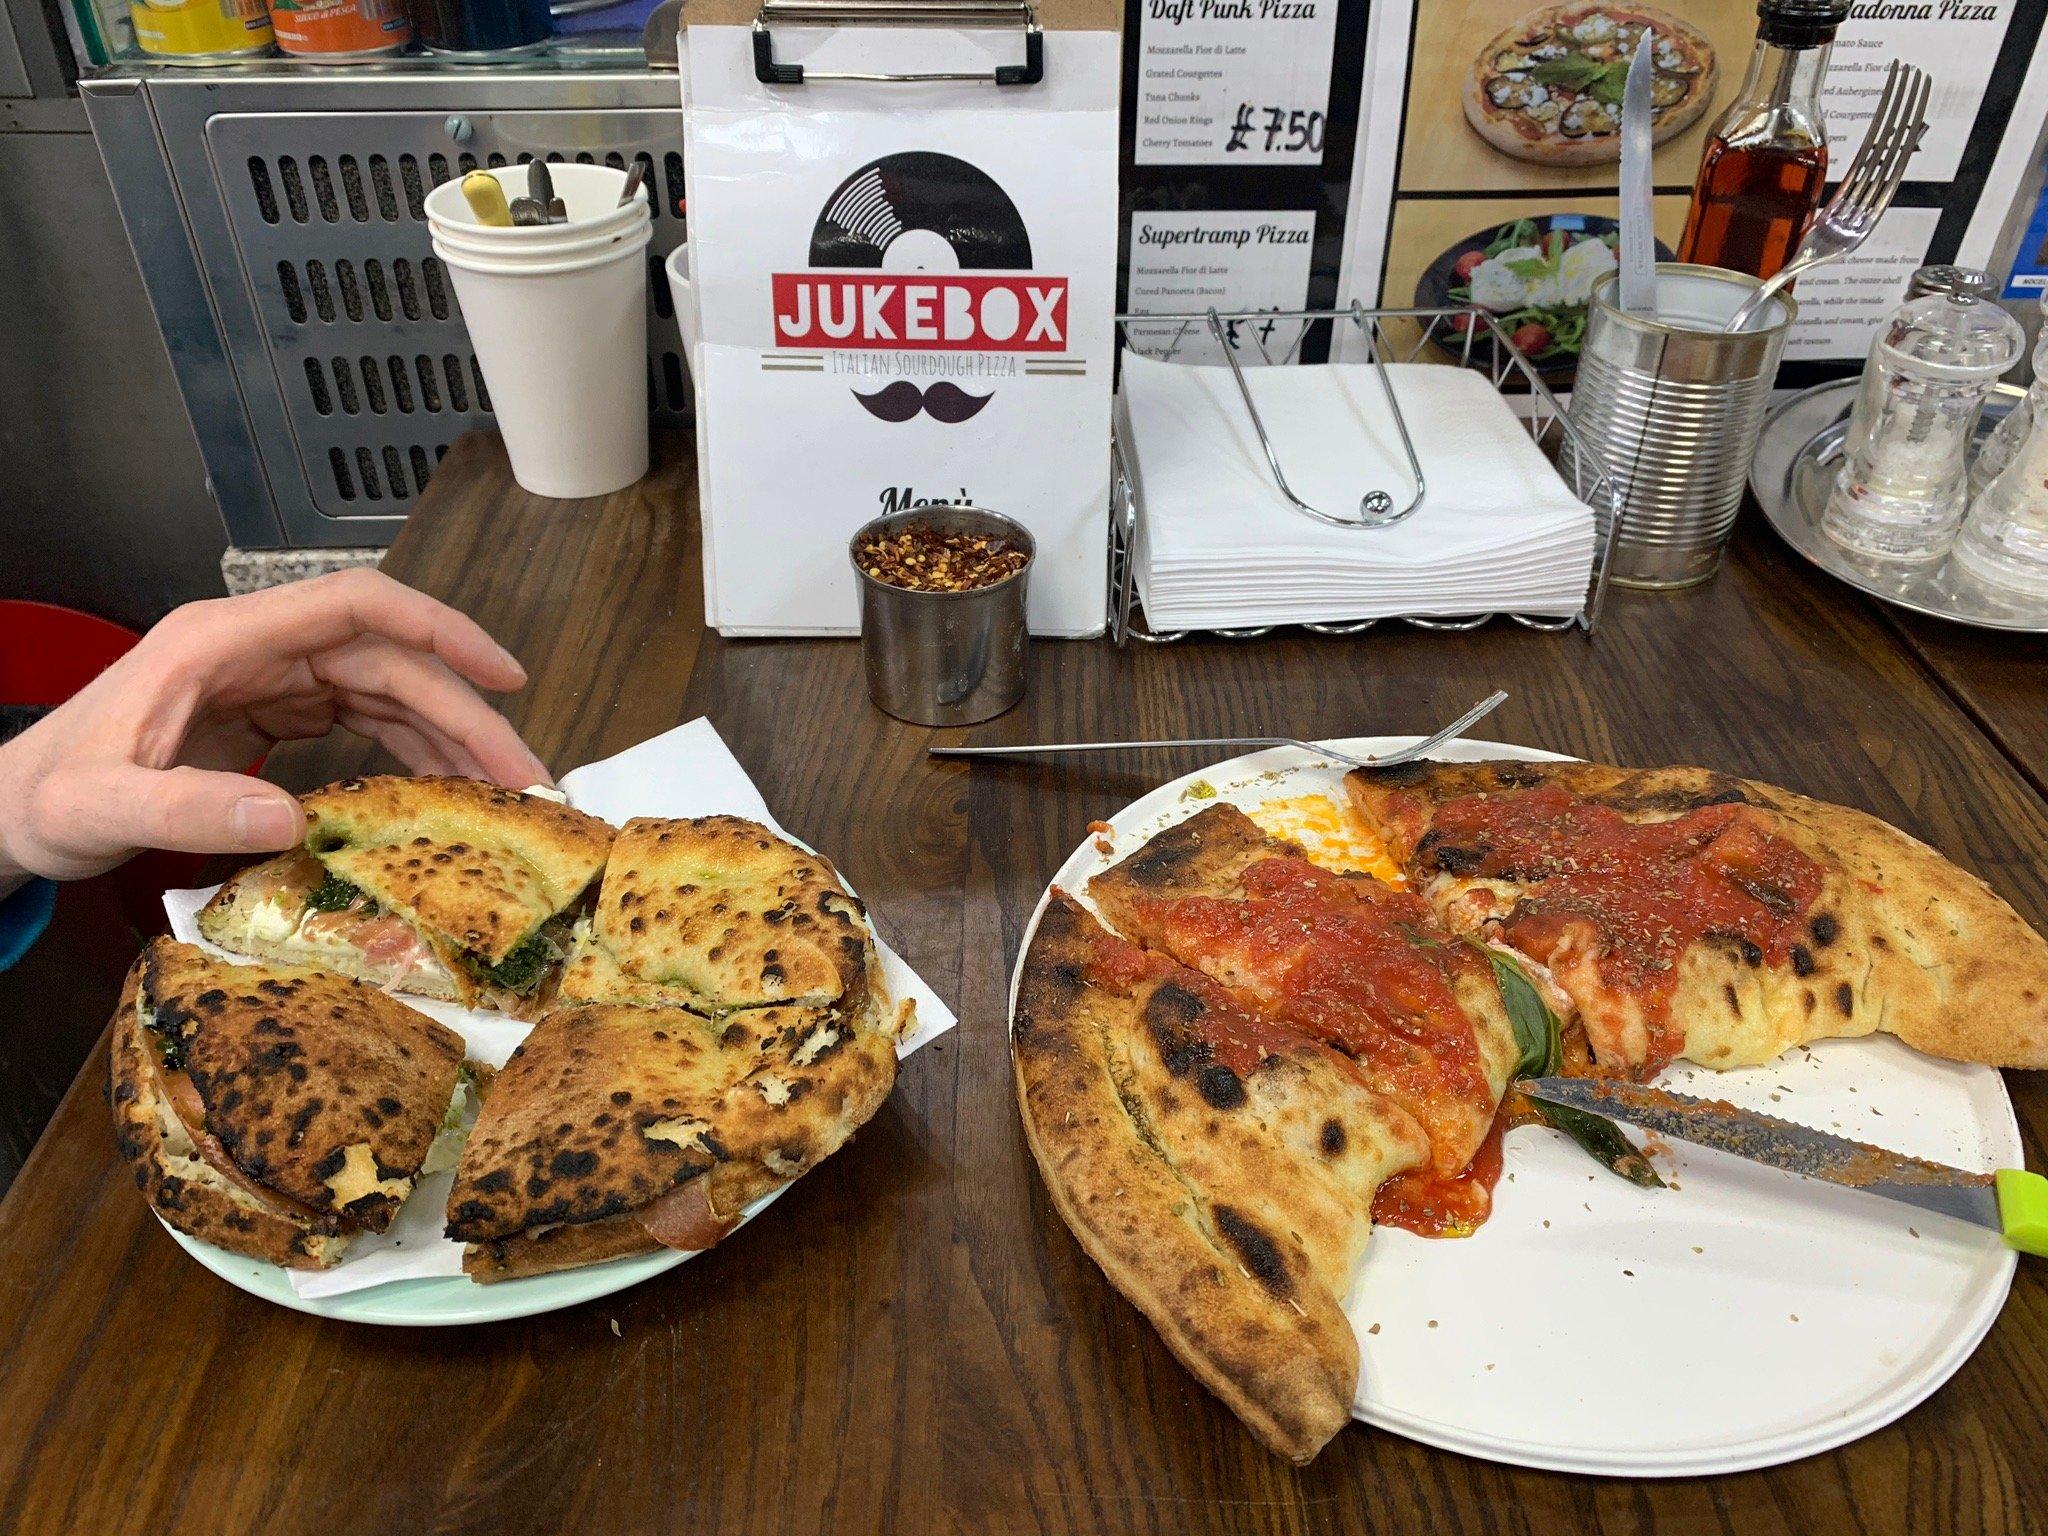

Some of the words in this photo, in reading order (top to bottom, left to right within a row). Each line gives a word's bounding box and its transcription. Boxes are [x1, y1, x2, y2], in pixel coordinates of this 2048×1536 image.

[1149, 0, 1194, 25] Daft
[1200, 0, 1253, 19] Punk
[1259, 0, 1317, 20] Pizza
[1850, 0, 1932, 21] adonna
[1938, 0, 1998, 21] Pizza
[1858, 39, 1884, 48] Sauce
[1147, 45, 1194, 55] Mozzarella
[1195, 45, 1213, 55] Fior
[1214, 45, 1223, 55] di
[1225, 45, 1247, 55] Latte
[1865, 63, 1883, 72] Fior
[1145, 69, 1174, 79] Grated
[1176, 69, 1223, 81] Courgettes
[1145, 92, 1166, 102] Tuna
[1168, 92, 1200, 102] Chunks
[1144, 116, 1160, 125] Red
[1161, 116, 1188, 125] Onion
[1189, 116, 1213, 127] Rings
[1226, 102, 1326, 153] £7.50
[1142, 138, 1171, 149] Cherry
[1173, 139, 1213, 148] Tomatoes
[1138, 224, 1251, 250] Supertramp
[1256, 224, 1311, 245] Pizza
[1137, 265, 1179, 275] Mozzarella
[1181, 266, 1198, 275] Fior
[1199, 266, 1207, 275] di
[1209, 266, 1228, 275] Latte
[1135, 287, 1160, 296] Cured
[1161, 287, 1195, 296] Pancetta
[1196, 287, 1227, 297] (Bacon)
[779, 283, 1065, 343] JUKEBOX
[1133, 328, 1171, 337] Parmesan
[1136, 347, 1153, 356] lack
[832, 350, 890, 375] ITALIAN
[895, 351, 973, 377] SOURDOUGH
[978, 353, 1016, 377] PIZZA
